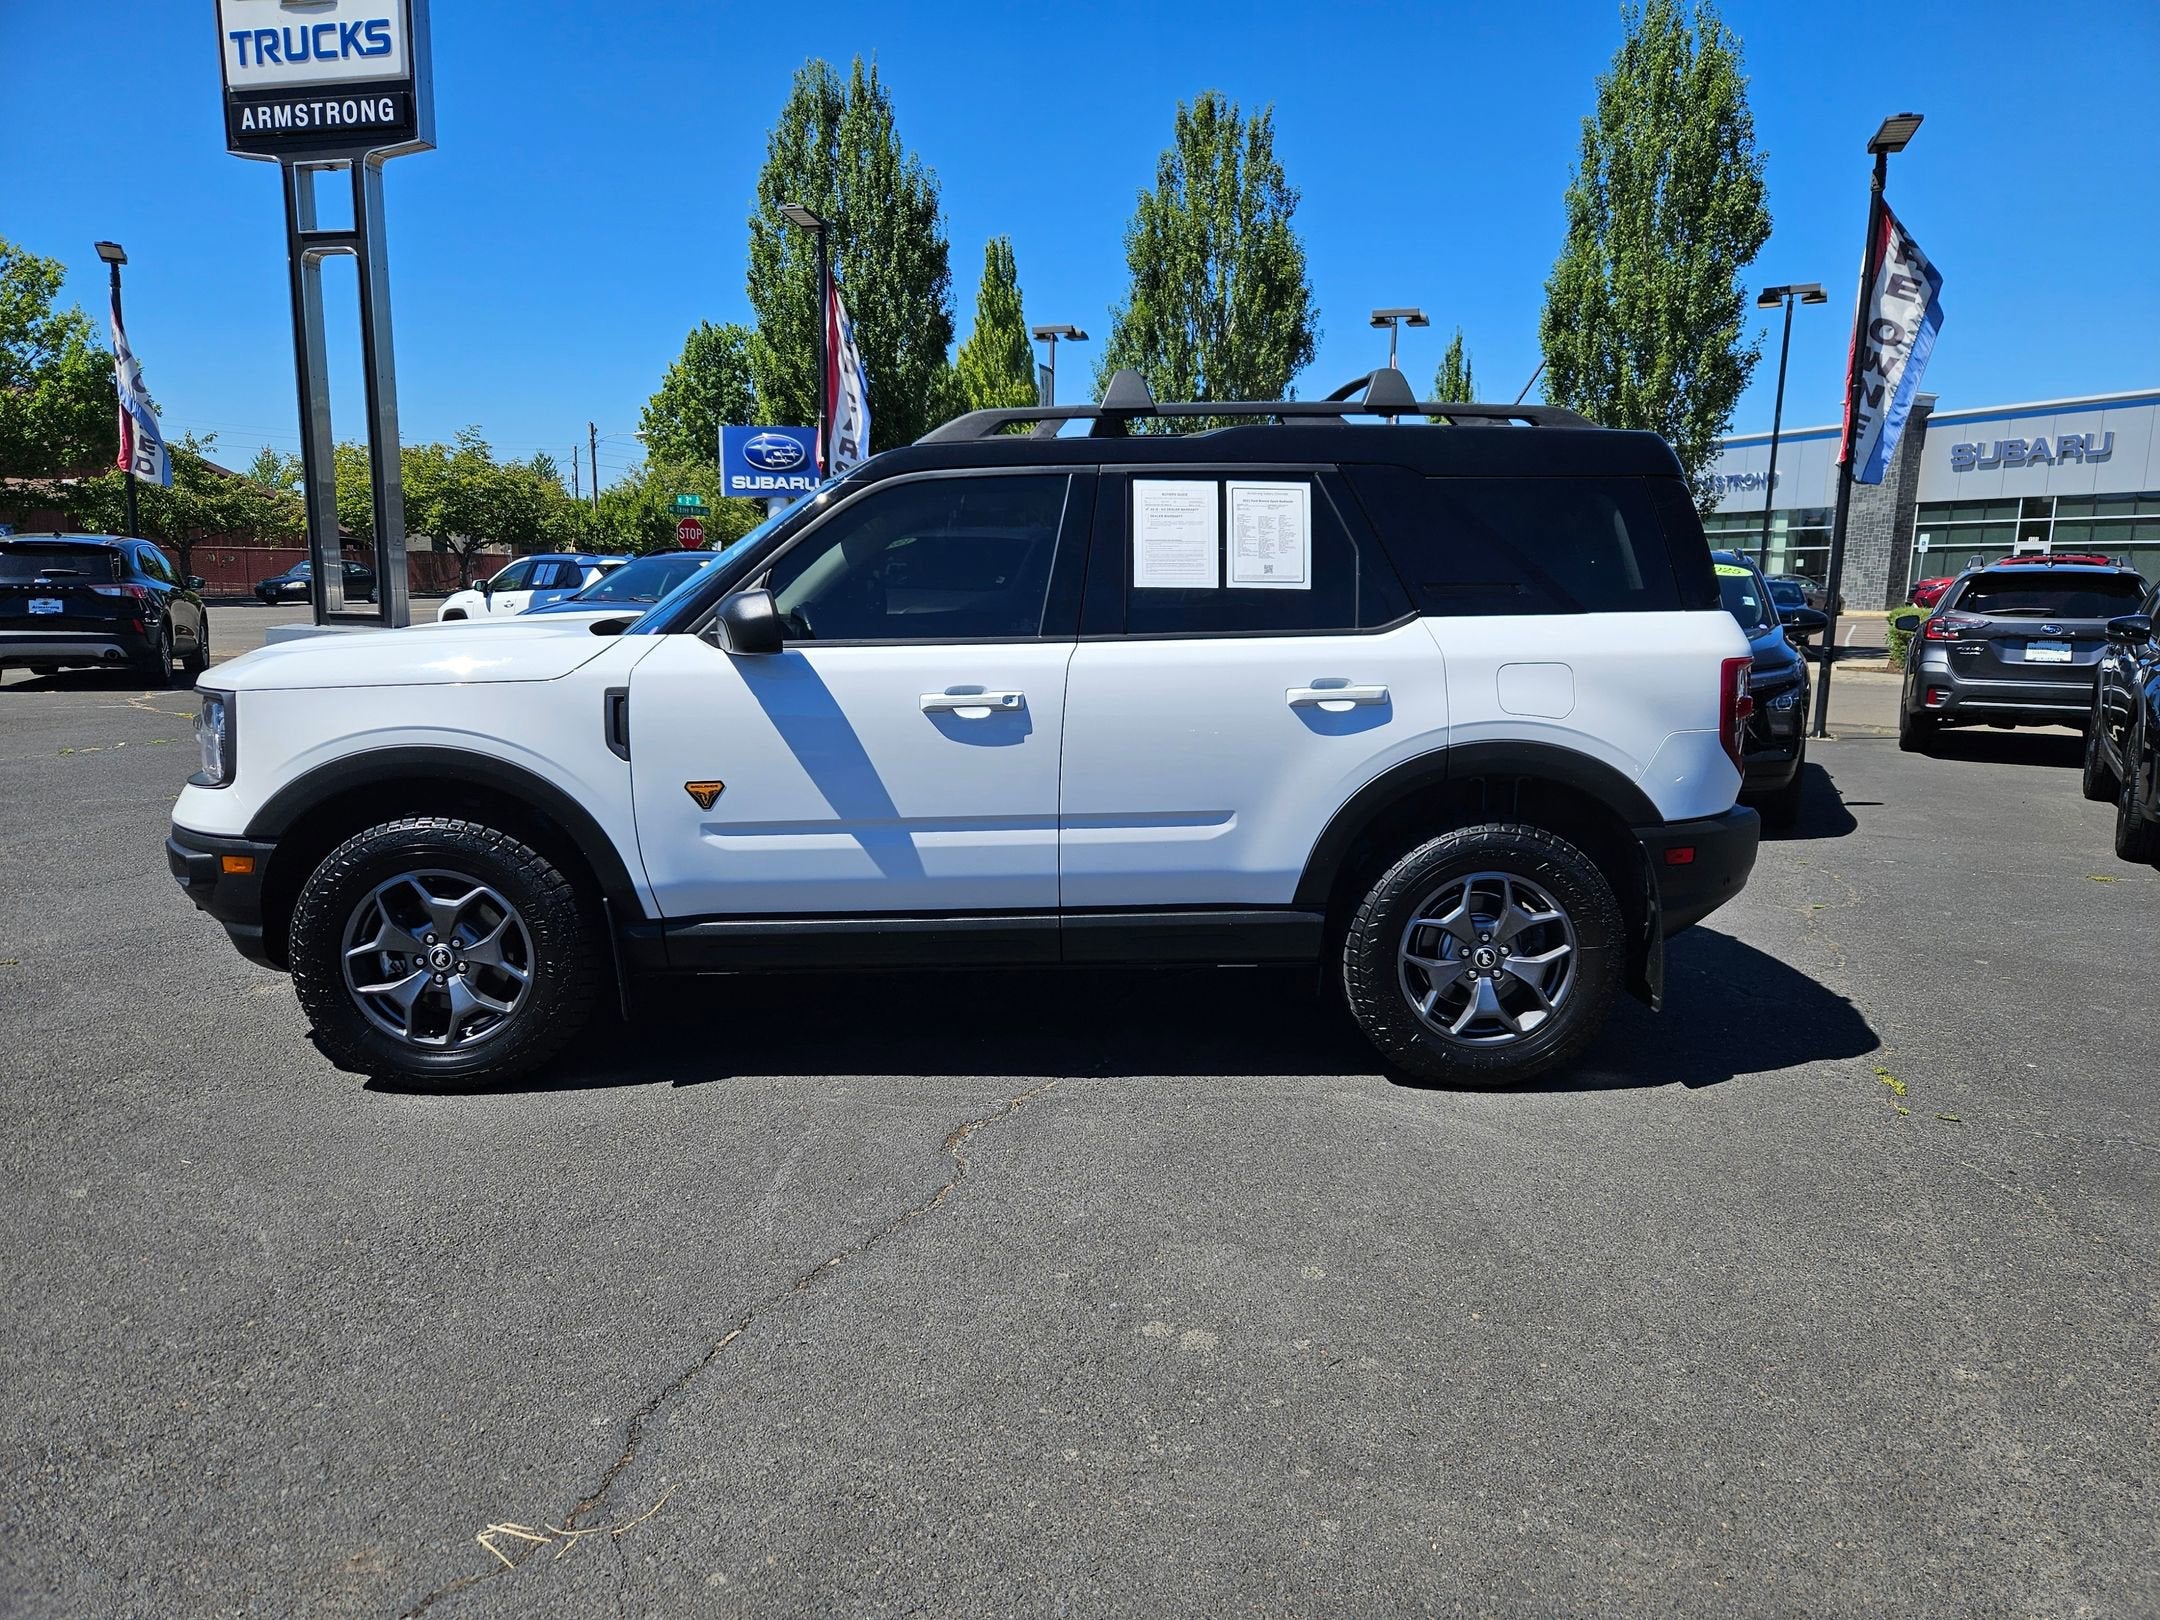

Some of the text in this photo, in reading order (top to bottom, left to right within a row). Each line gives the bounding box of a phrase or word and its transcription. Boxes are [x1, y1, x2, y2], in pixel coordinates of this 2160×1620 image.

[229, 18, 391, 66] TRUCKS
[241, 98, 394, 130] ARMSTRONG
[1951, 432, 2115, 466] SUBARU
[679, 528, 702, 539] STOP
